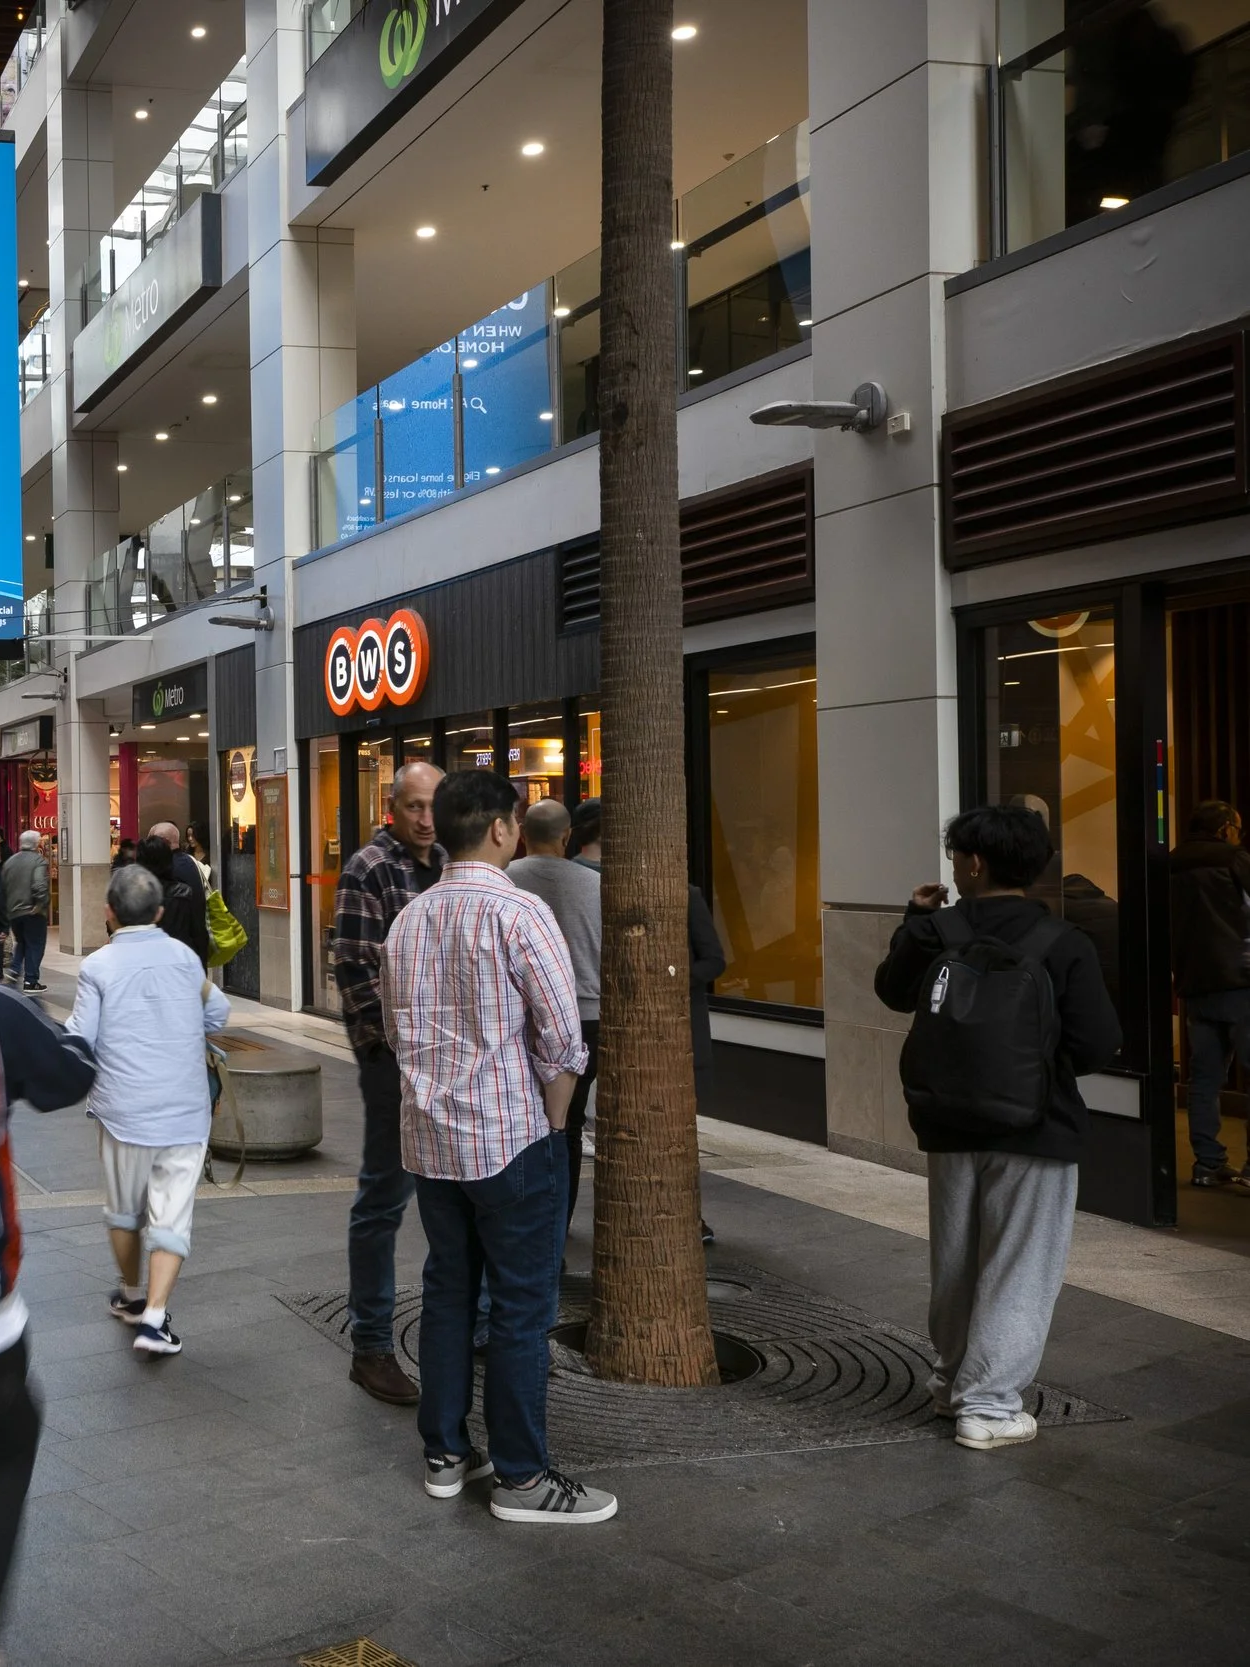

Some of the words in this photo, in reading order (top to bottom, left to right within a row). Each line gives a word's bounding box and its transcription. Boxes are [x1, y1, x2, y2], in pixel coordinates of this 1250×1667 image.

[124, 278, 159, 340] Metro
[335, 641, 406, 688] BWS
[164, 684, 184, 708] Metro
